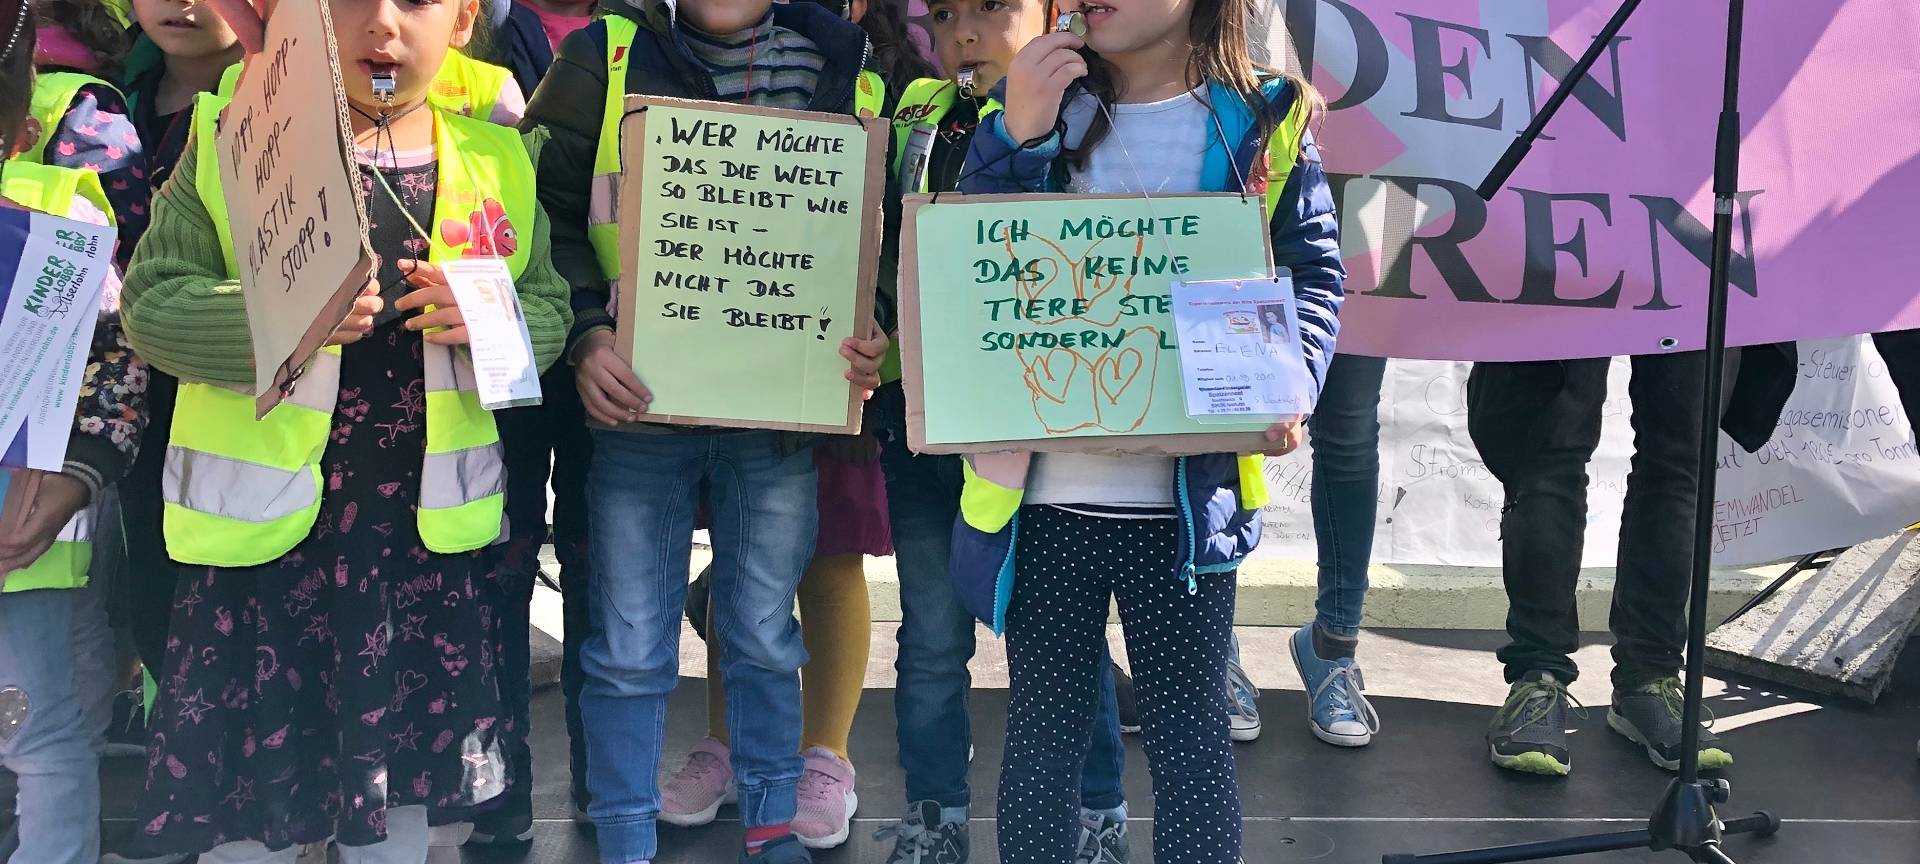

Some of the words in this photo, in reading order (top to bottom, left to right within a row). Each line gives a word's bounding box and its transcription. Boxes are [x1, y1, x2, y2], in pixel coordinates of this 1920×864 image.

[1284, 0, 1633, 142] DEN
[757, 127, 845, 154] MÖCHTE
[662, 156, 707, 174] DAS
[719, 160, 760, 180] DIE
[775, 164, 843, 187] WELT
[660, 181, 686, 199] SO
[696, 184, 794, 208] BLEIBT
[807, 197, 848, 214] WIE
[660, 212, 699, 229] SIE
[708, 218, 739, 233] IST
[977, 219, 1028, 244] ICH
[1060, 215, 1200, 239] MÖCHTE
[654, 239, 704, 261] DER
[1325, 173, 1765, 311] REN
[53, 261, 77, 293] LOBBY
[973, 257, 1045, 283] DAS
[1085, 254, 1190, 279] KEINE
[23, 255, 67, 314] KINDER
[61, 267, 89, 305] Iserlohn
[654, 271, 730, 293] NICHT
[747, 280, 795, 297] DAS
[662, 302, 701, 320] SIE
[984, 297, 1088, 321] TIERE
[980, 328, 1126, 351] SONDERN
[1714, 485, 1804, 522] EMWANDEL
[1712, 517, 1764, 553] JETZT
